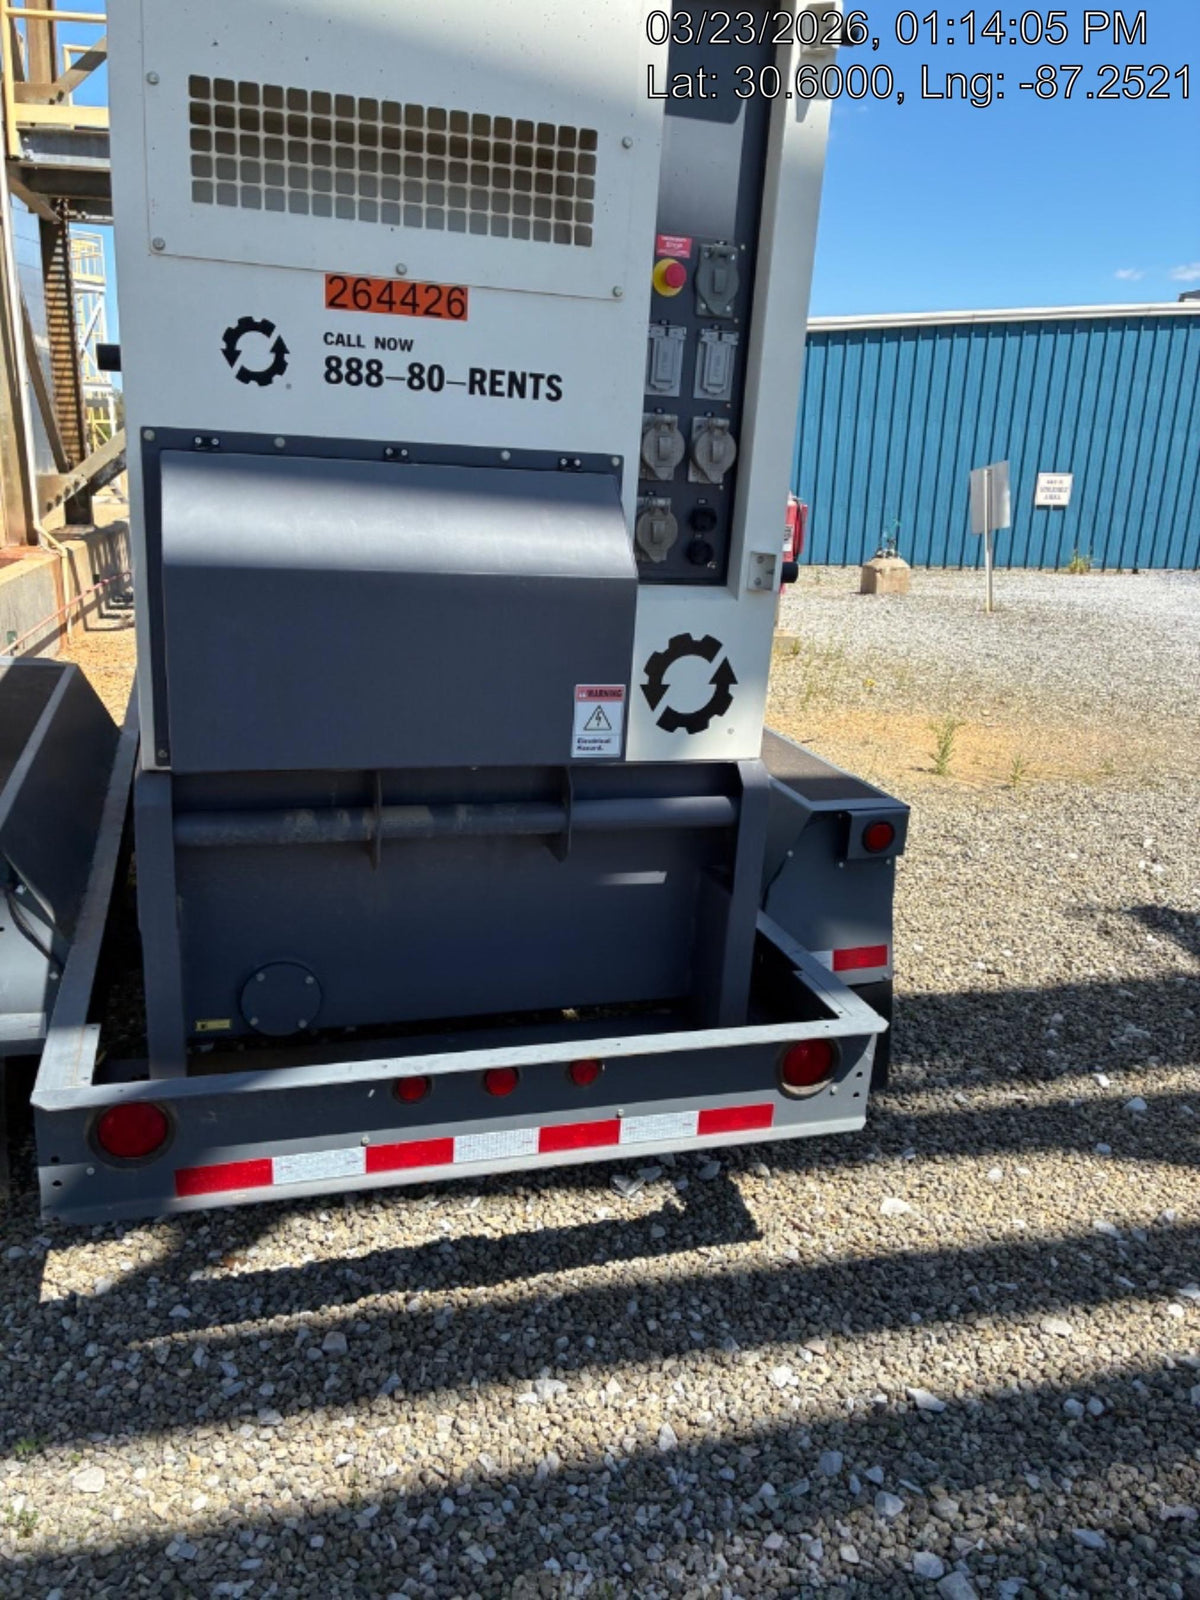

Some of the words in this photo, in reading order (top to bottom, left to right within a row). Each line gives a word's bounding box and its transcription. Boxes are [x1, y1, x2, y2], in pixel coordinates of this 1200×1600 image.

[327, 275, 467, 319] 264426
[323, 331, 365, 349] CALL
[374, 335, 414, 352] NOW
